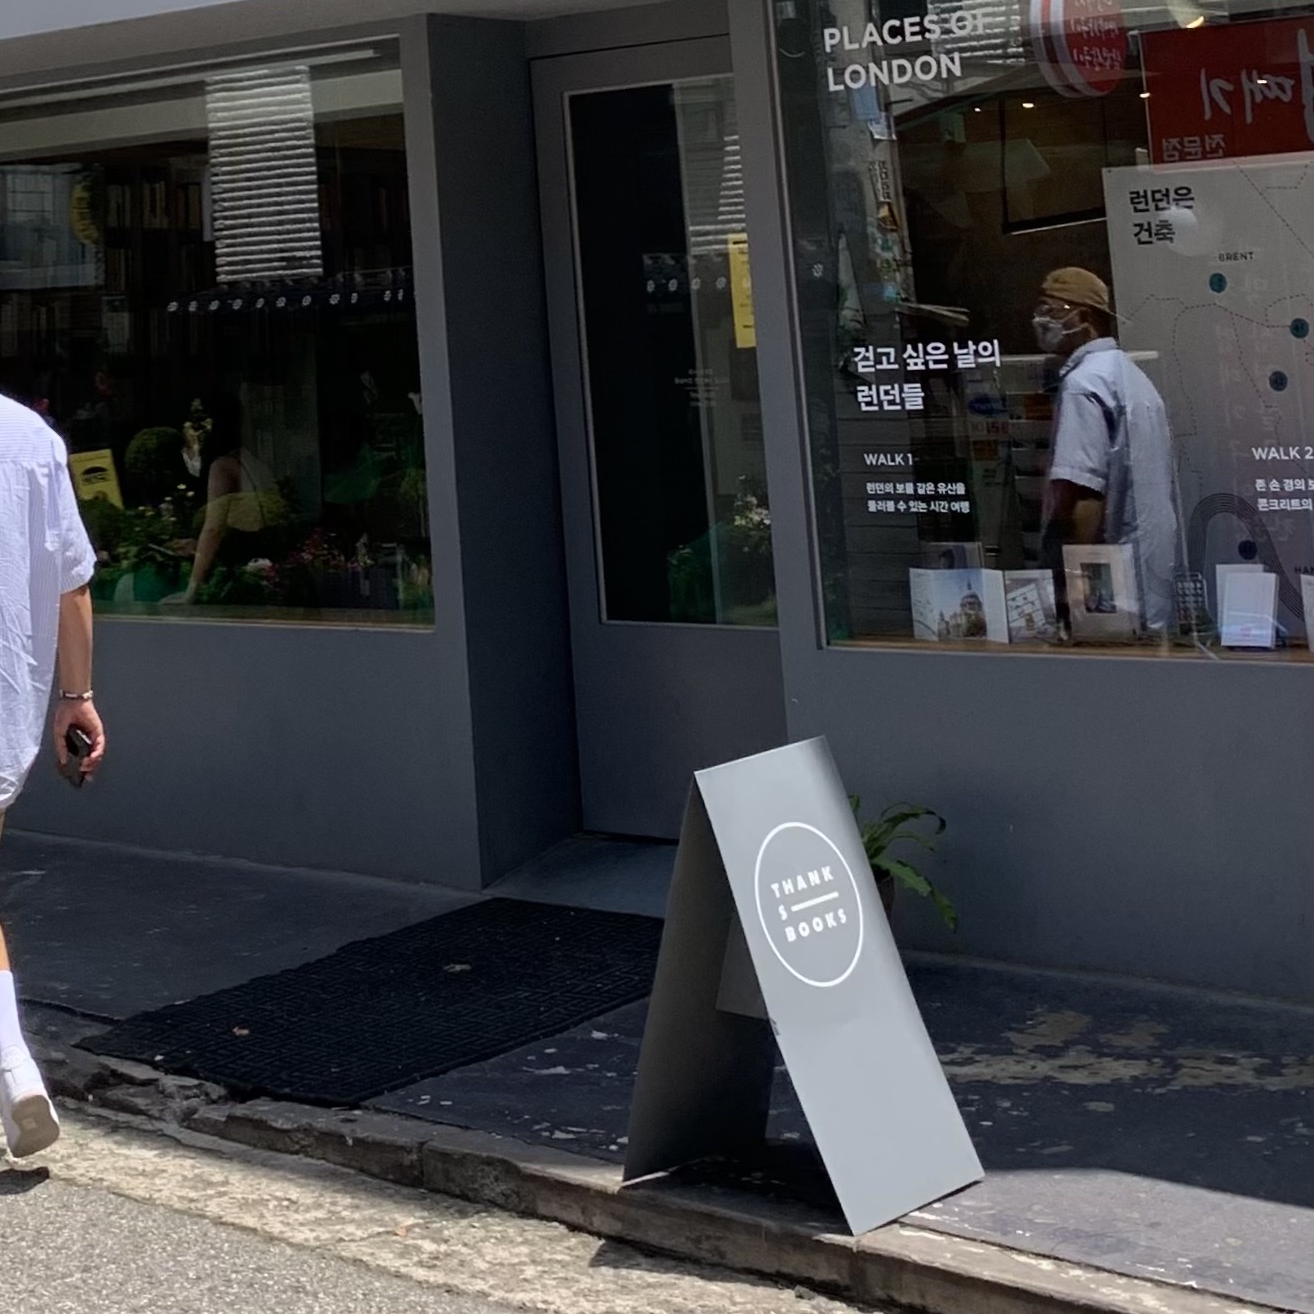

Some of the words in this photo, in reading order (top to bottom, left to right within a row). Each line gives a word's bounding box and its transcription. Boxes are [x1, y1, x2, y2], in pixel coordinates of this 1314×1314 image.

[823, 13, 941, 53] PLACES
[827, 52, 962, 92] LONDON
[1129, 186, 1195, 214] 런던은
[1133, 219, 1176, 246] 건축
[1218, 251, 1255, 263] BRENT
[853, 345, 899, 373] 걷고
[902, 342, 949, 371] 싶은
[953, 339, 1001, 369] 날의
[856, 383, 925, 411] 런던들
[863, 453, 905, 466] WALK
[1251, 446, 1301, 460] WALK
[1304, 446, 1314, 460] 2
[897, 500, 907, 512] 수
[929, 500, 949, 513] 시간
[770, 865, 835, 898] THANK
[784, 908, 847, 942] BOOKS
